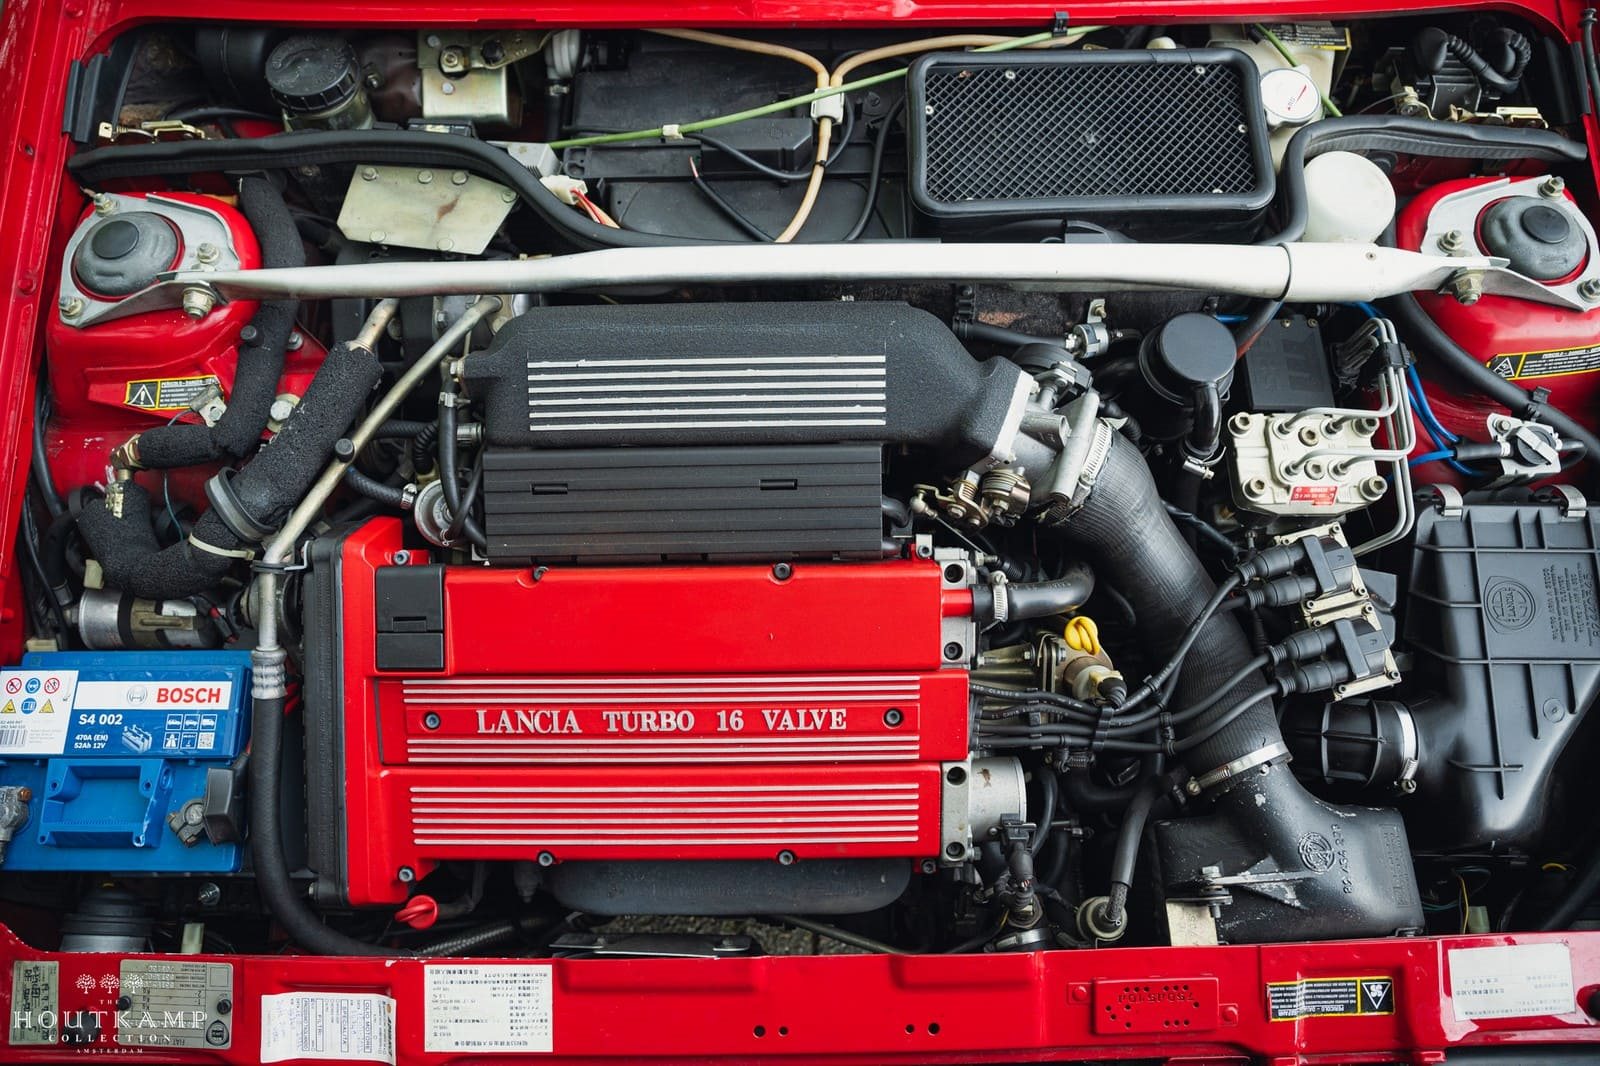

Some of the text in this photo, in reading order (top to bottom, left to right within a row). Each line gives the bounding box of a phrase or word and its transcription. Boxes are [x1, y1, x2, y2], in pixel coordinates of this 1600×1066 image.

[156, 687, 221, 703] BOSCH
[78, 713, 123, 725] S4 002
[476, 708, 846, 734] LANCIA TURBO 16 VALVE
